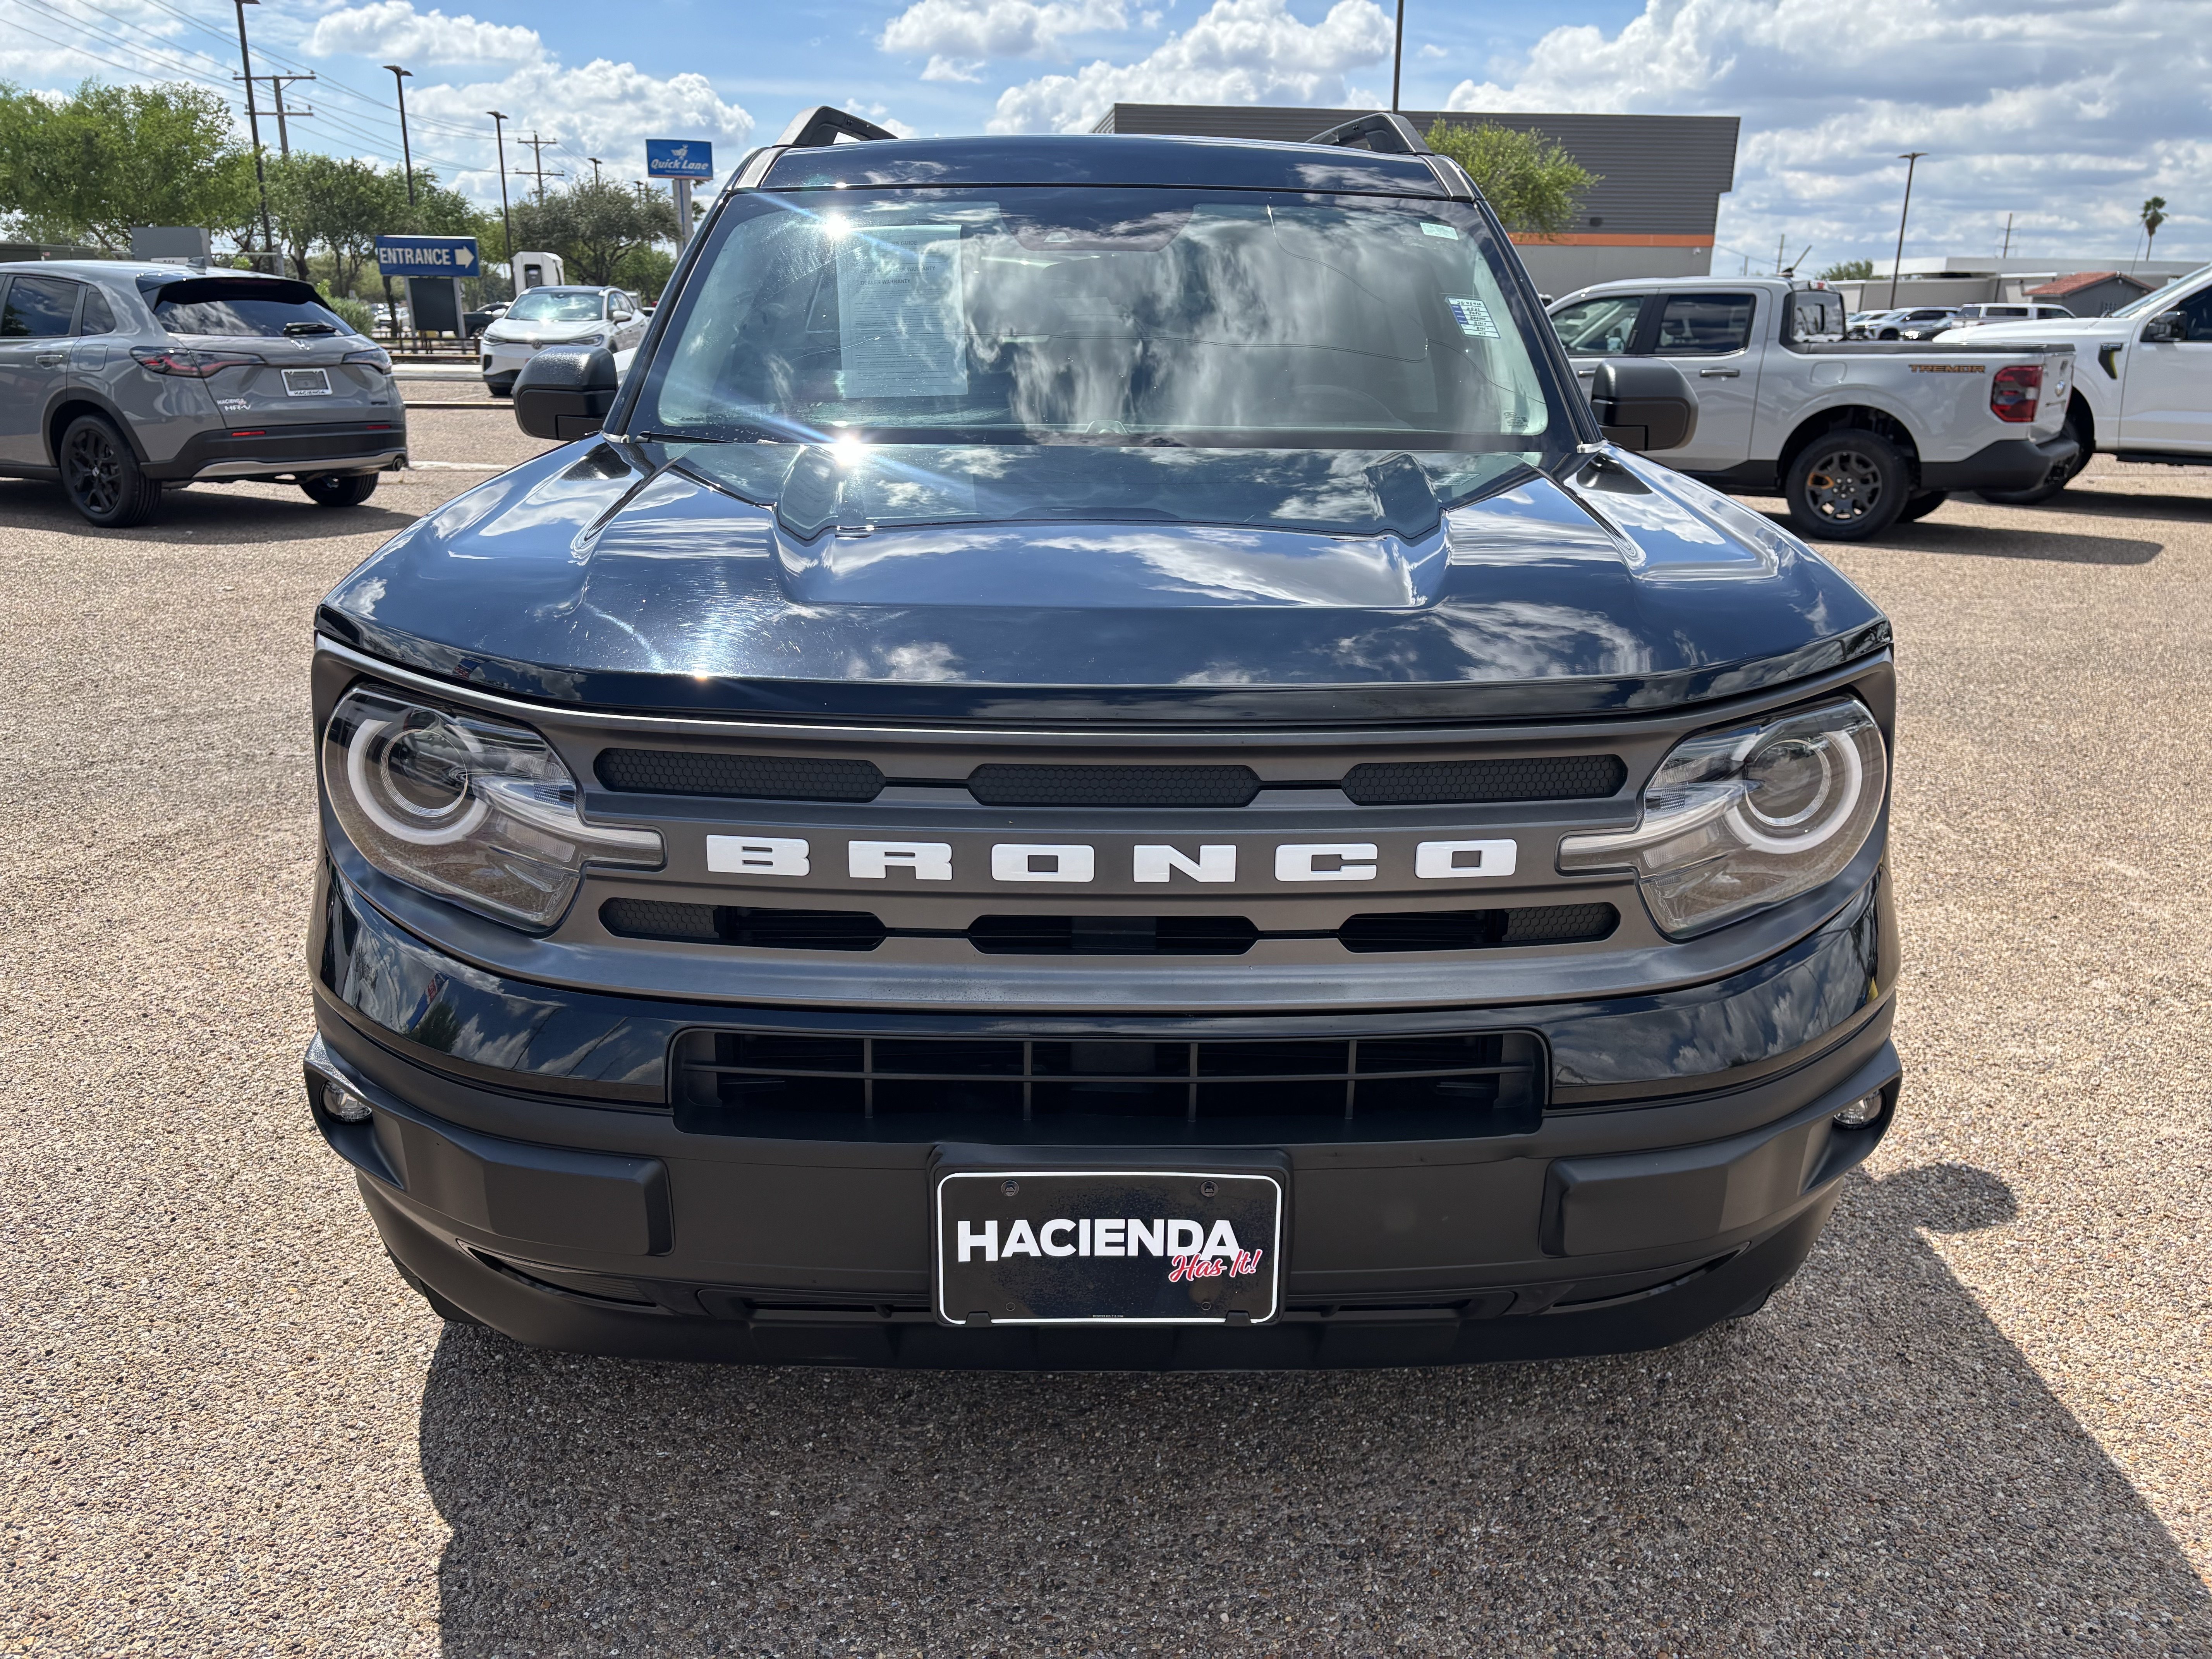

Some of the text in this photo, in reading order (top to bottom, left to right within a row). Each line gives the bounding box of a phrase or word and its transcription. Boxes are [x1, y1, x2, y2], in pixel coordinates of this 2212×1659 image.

[651, 158, 709, 170] Quick Lane
[379, 247, 452, 265] ENTRANCE
[1908, 364, 1985, 373] TREMOR
[706, 834, 1517, 883] BRONCO
[957, 1218, 1240, 1262] HACIENDA
[1168, 1249, 1263, 1283] Has It!
